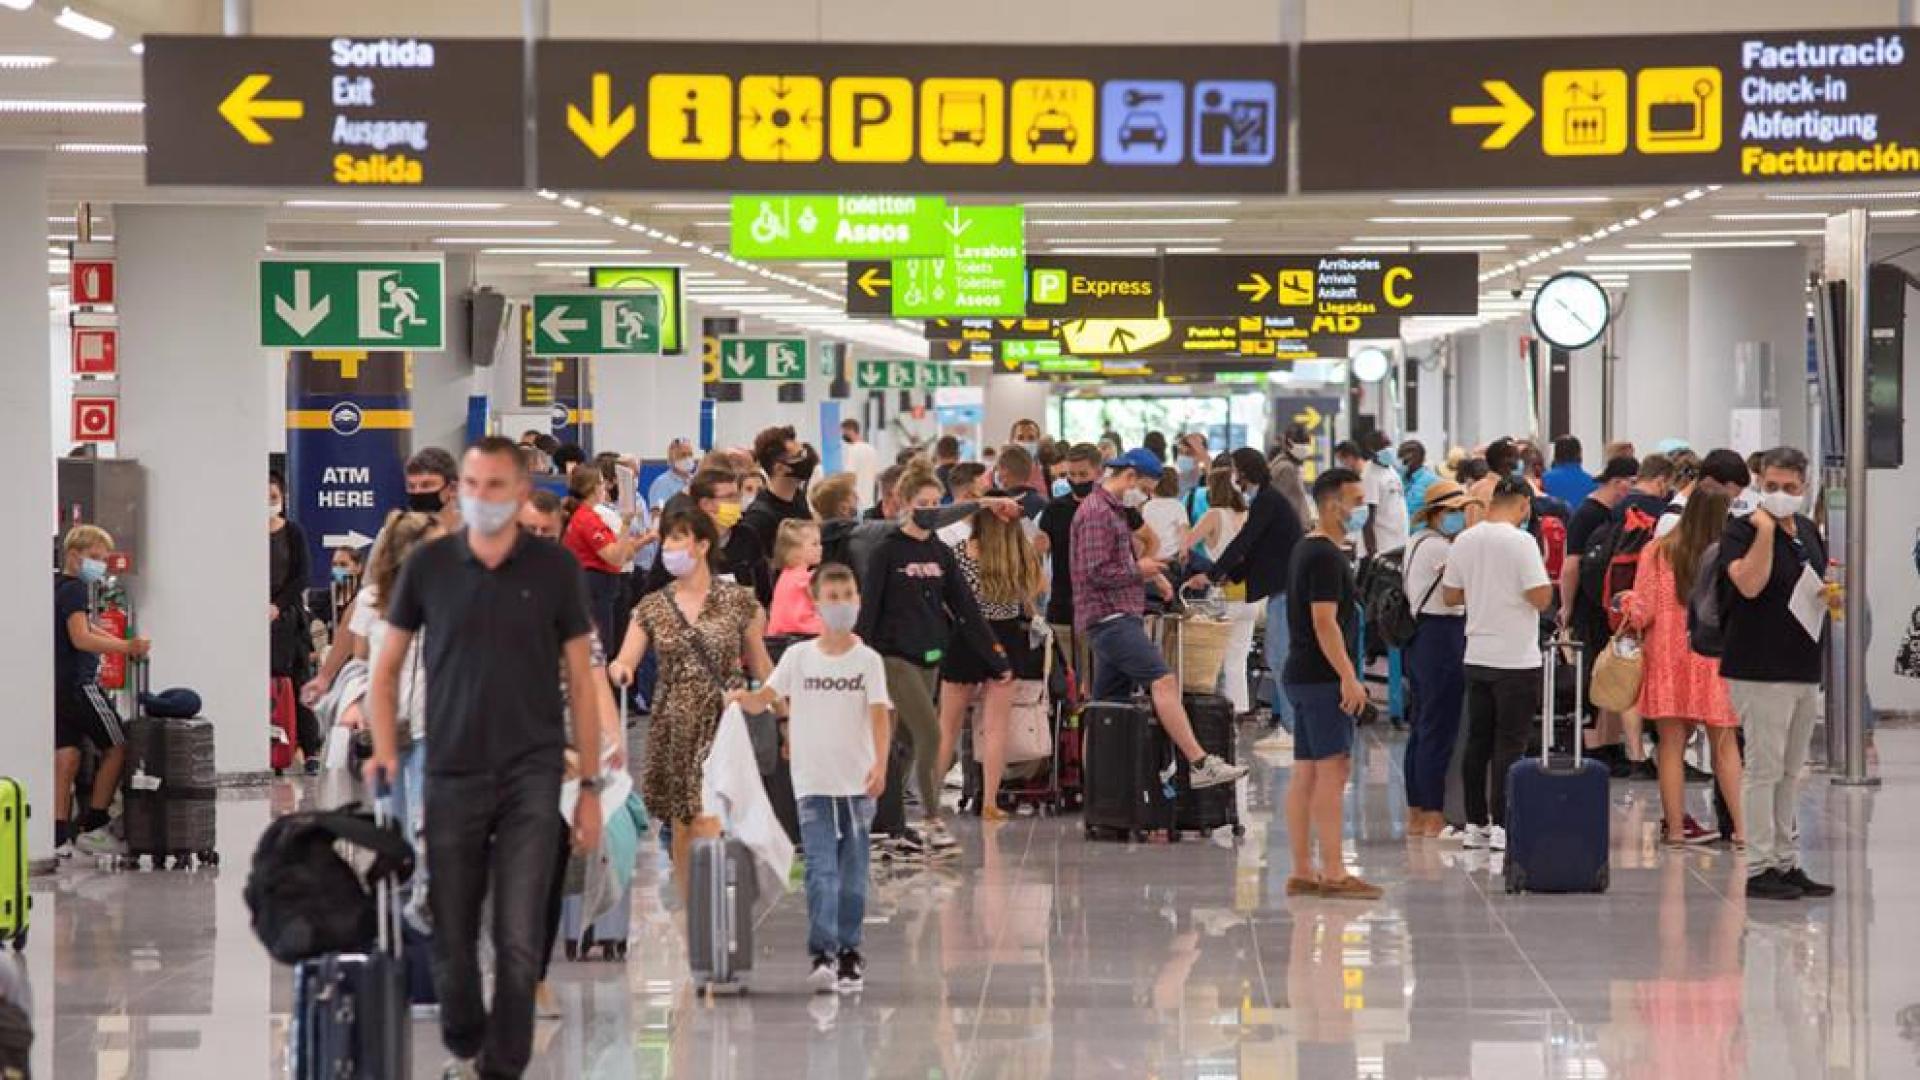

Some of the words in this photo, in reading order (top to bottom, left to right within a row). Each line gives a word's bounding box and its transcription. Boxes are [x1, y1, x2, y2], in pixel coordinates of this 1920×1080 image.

[331, 38, 435, 67] Sortida
[1741, 35, 1905, 70] Facturació
[332, 75, 374, 106] Exit
[1031, 86, 1078, 101] TAXI
[1741, 74, 1847, 105] Check-in
[332, 114, 428, 151] Ausgang
[852, 93, 891, 148] P
[1740, 109, 1879, 142] Abfertigung
[333, 152, 423, 184] Salida
[1741, 142, 1920, 175] Facturación
[835, 219, 910, 243] Aseos
[954, 243, 1018, 258] Lavabos
[1319, 258, 1380, 271] Arribades
[955, 293, 1003, 307] Aseos
[1040, 275, 1060, 298] P
[1071, 277, 1151, 299] Express
[1383, 266, 1413, 308] C
[323, 467, 370, 484] ATM
[318, 490, 375, 507] HERE
[803, 673, 866, 691] mood.
